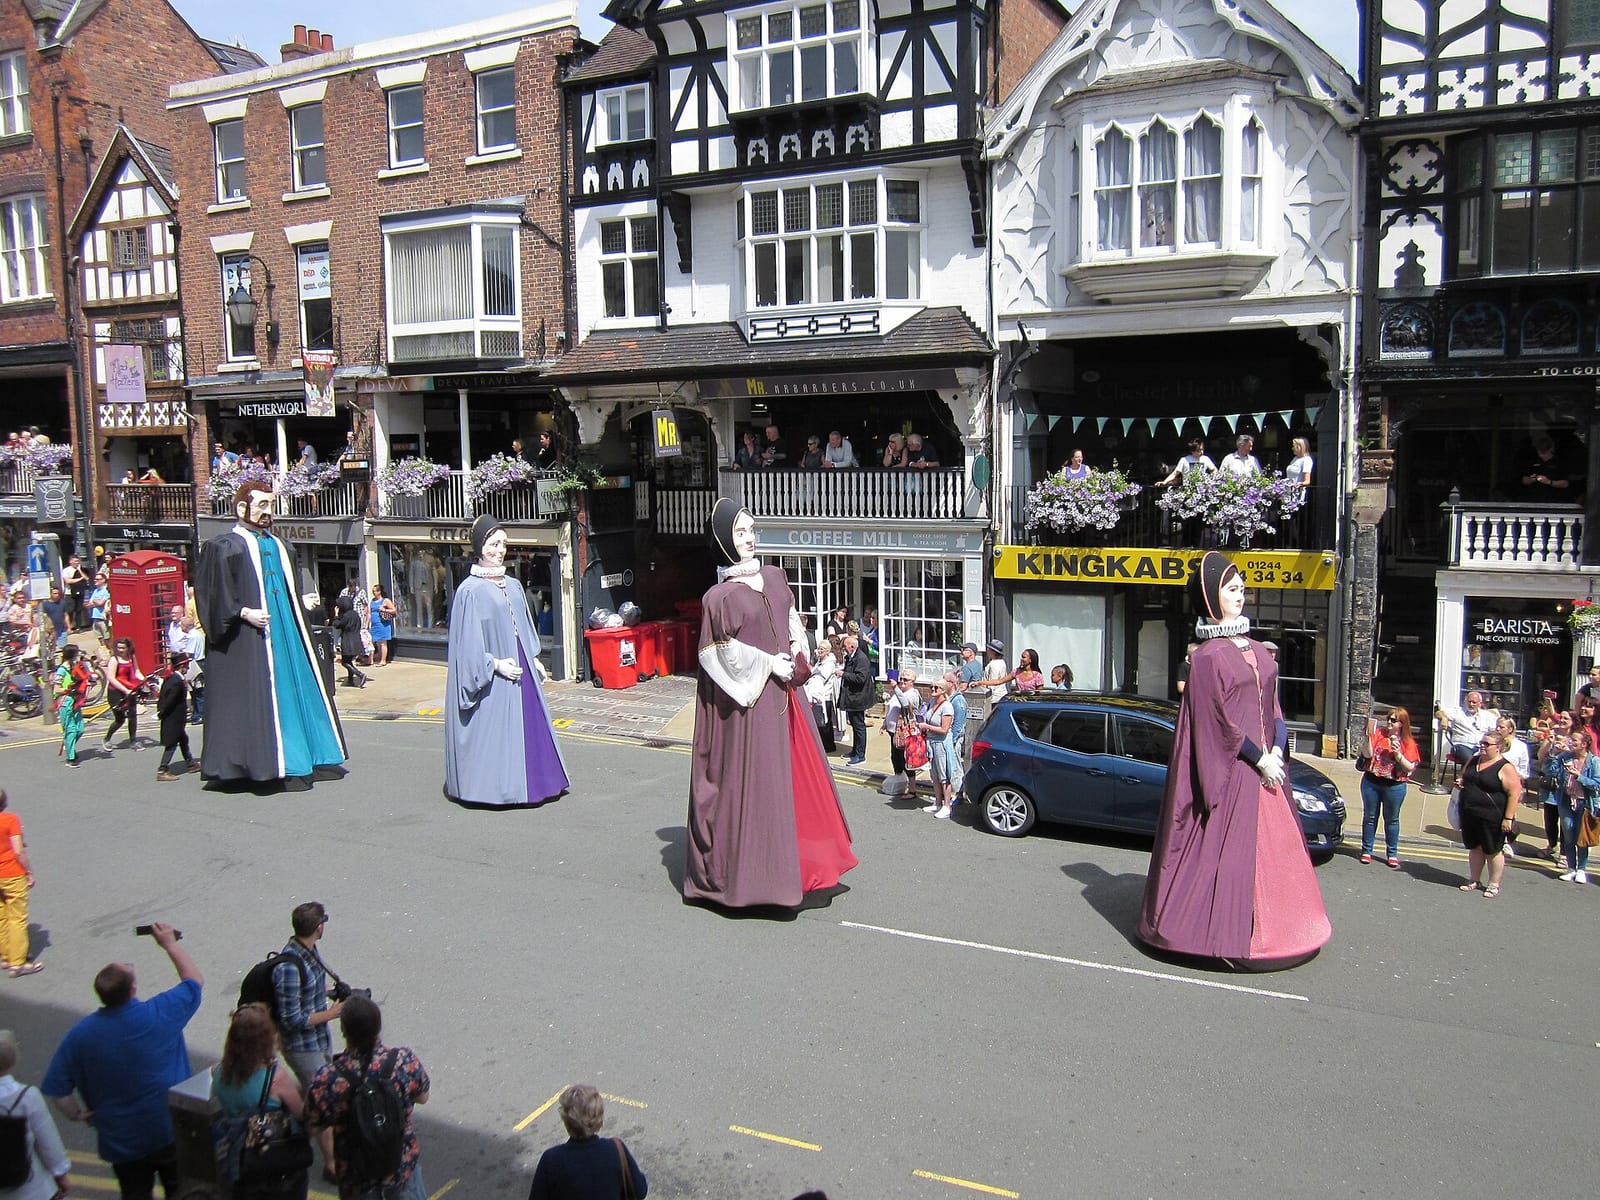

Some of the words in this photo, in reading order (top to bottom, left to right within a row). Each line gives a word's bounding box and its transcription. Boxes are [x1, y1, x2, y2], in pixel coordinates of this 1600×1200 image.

[1539, 368, 1559, 376] TO
[364, 379, 408, 392] DEVA
[438, 376, 468, 387] DEVA
[474, 375, 518, 385] TRAVEL
[238, 402, 306, 416] NETHERWORL
[270, 525, 315, 539] INTAGE
[430, 528, 457, 539] CITY
[788, 530, 853, 545] COFFEE
[863, 531, 907, 546] MILL
[1247, 561, 1281, 570] 01244
[1253, 571, 1275, 583] 34
[1281, 571, 1303, 584] 34
[1484, 618, 1553, 634] BARISTA
[1492, 635, 1519, 643] COFFEE
